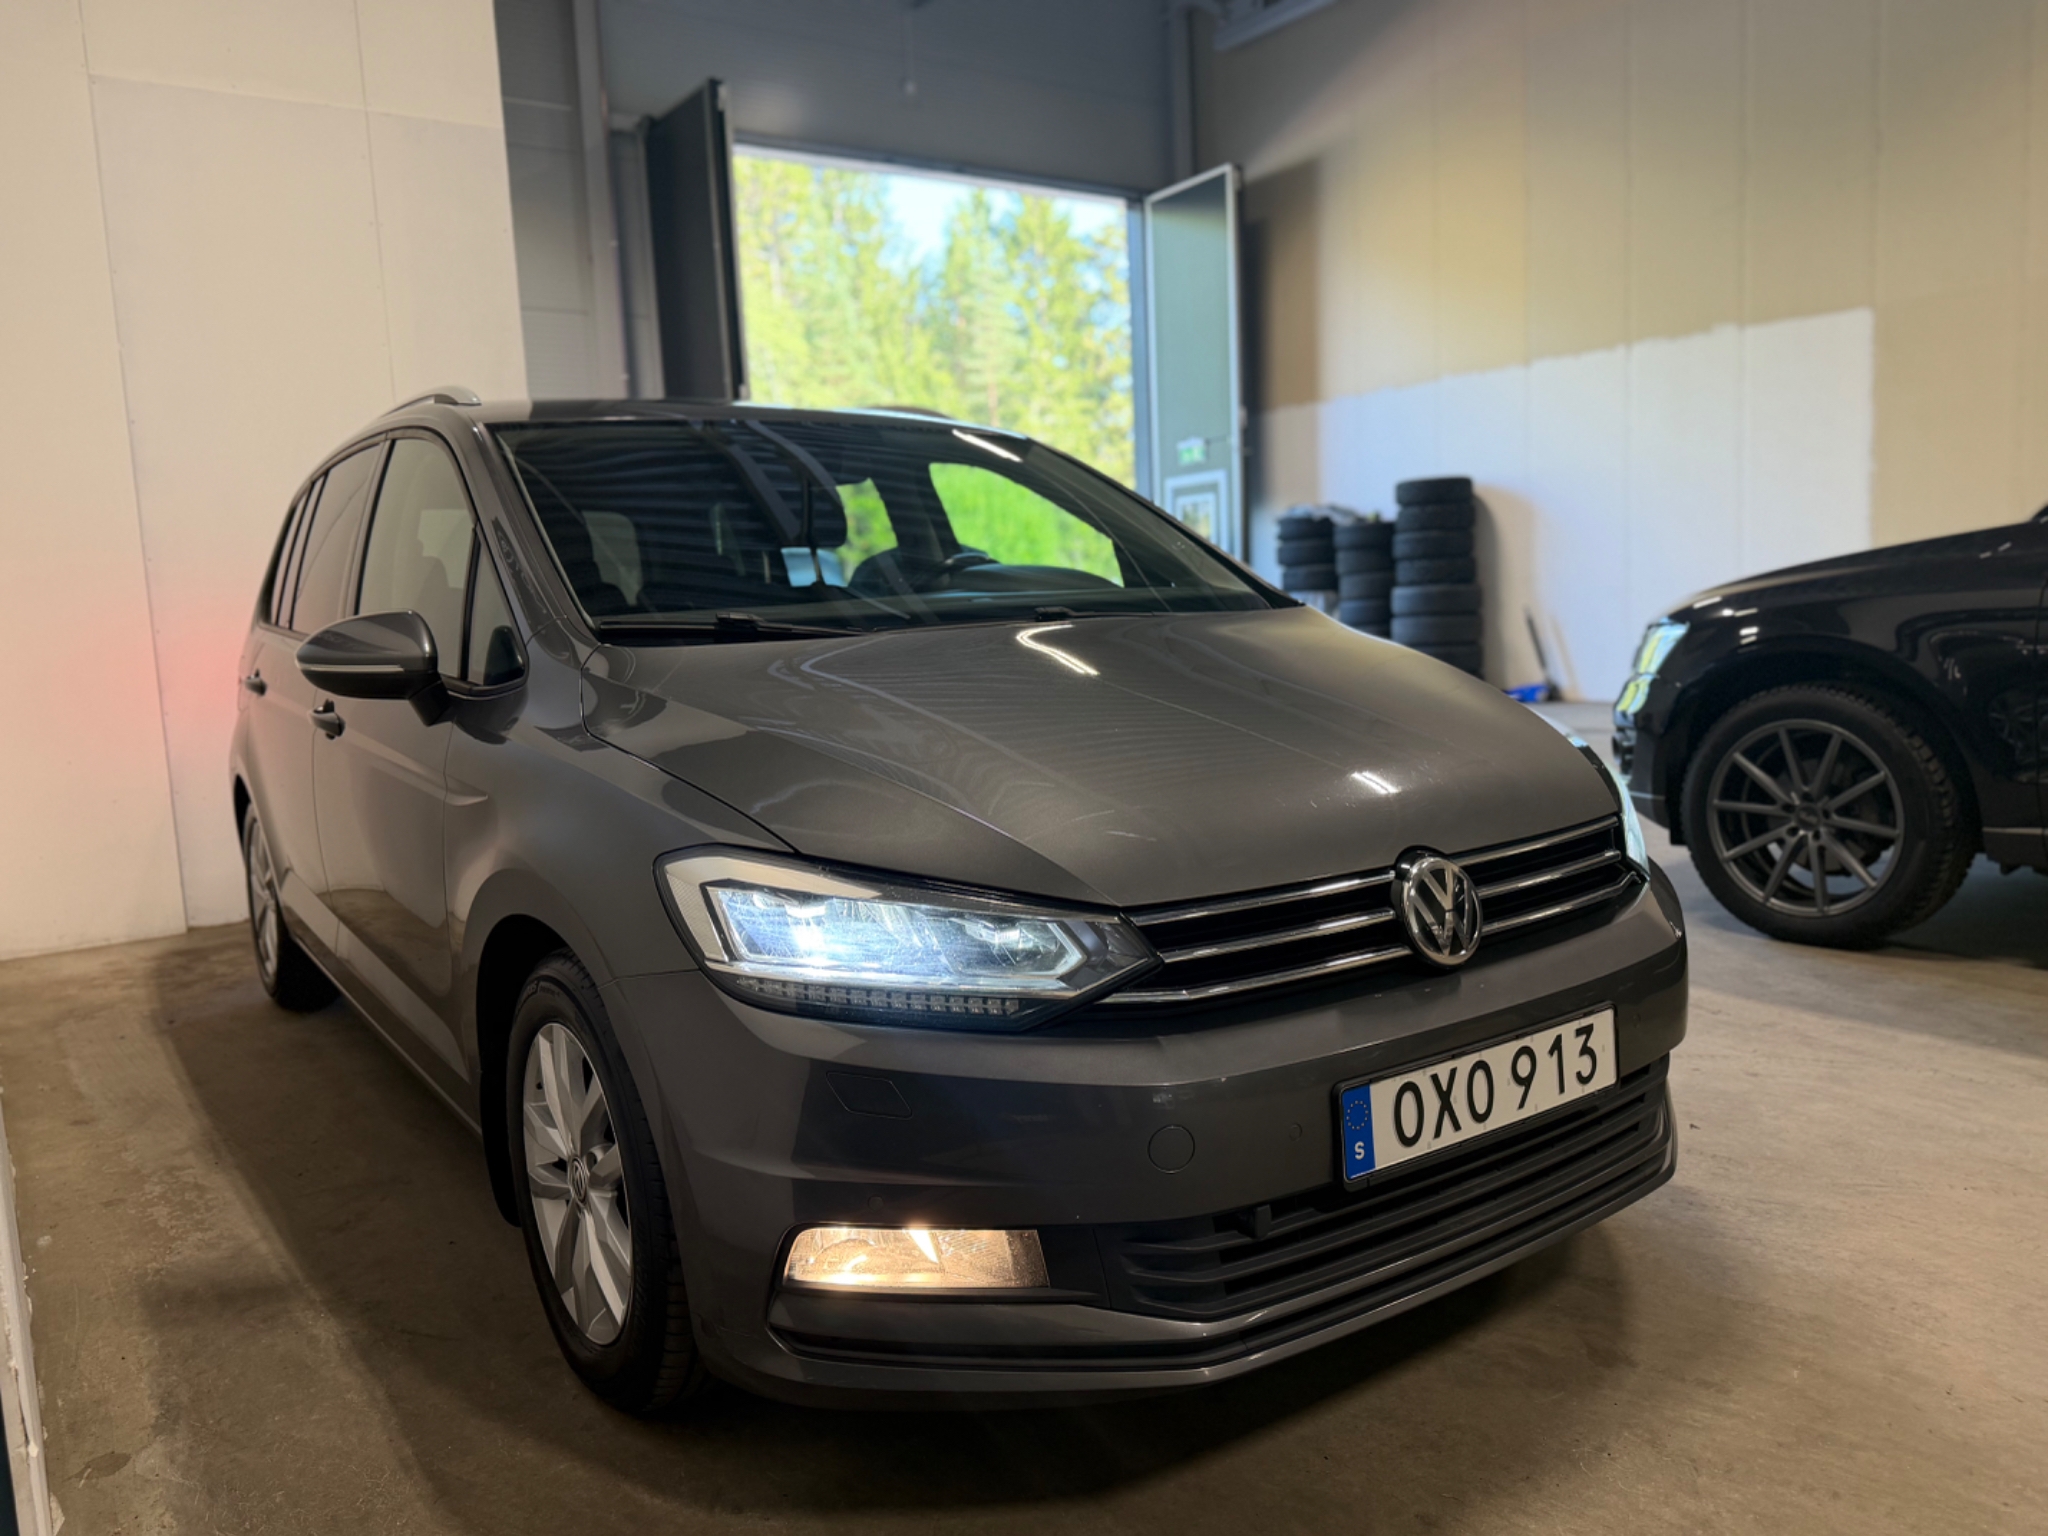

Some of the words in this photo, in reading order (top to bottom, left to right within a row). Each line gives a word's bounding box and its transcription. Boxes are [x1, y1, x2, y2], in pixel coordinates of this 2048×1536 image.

[1394, 1060, 1494, 1147] OXO
[1511, 1023, 1597, 1110] 913
[1354, 1141, 1365, 1160] S
